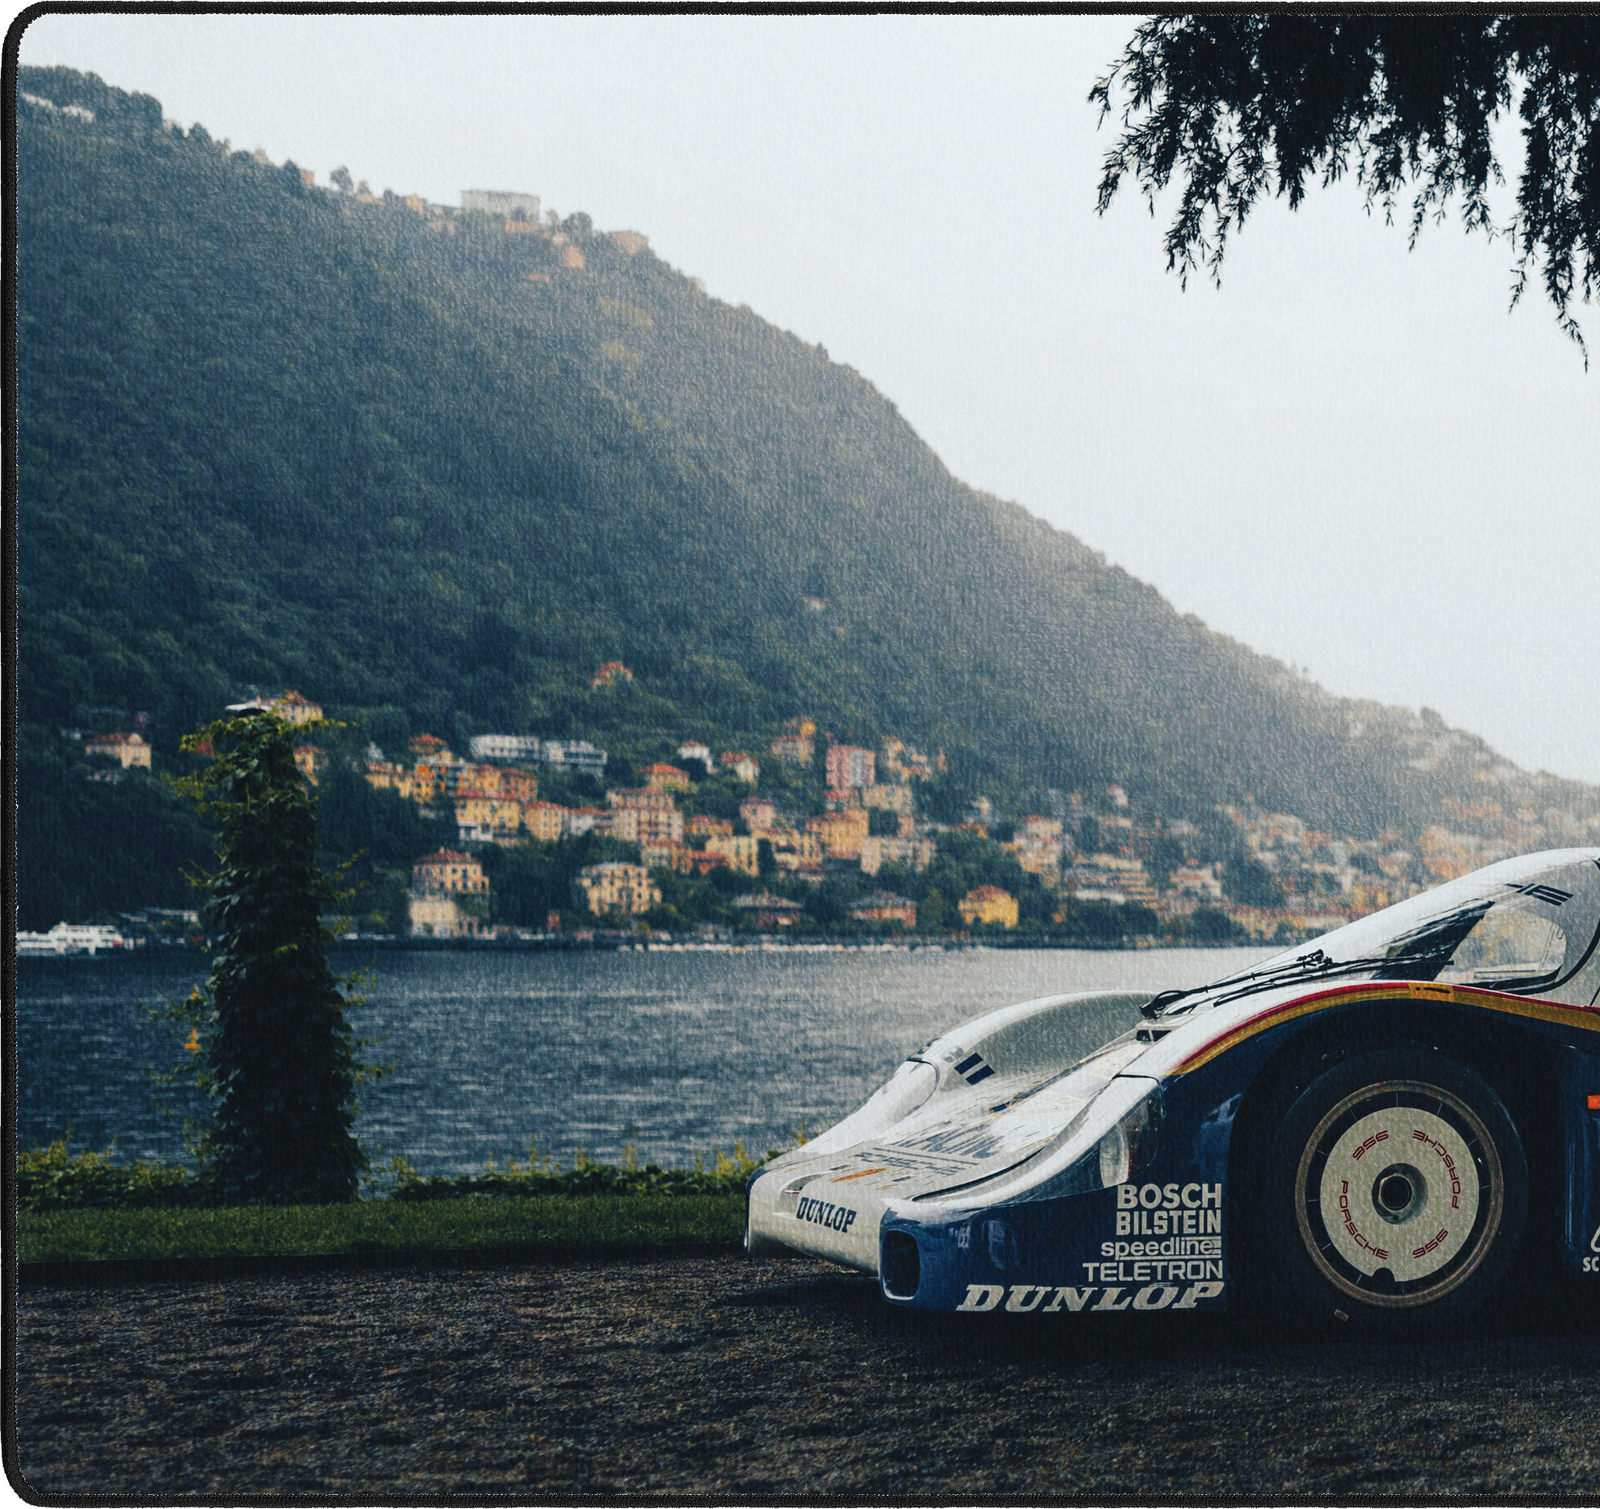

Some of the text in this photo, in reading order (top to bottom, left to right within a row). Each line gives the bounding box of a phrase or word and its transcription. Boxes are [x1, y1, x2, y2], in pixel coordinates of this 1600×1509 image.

[1412, 1129, 1461, 1209] PORSCHE
[1117, 1183, 1222, 1209] BOSCH
[796, 1197, 857, 1233] DUNLOP
[1116, 1210, 1222, 1235] BILSTEIN
[1339, 1180, 1389, 1260] PORSCHE
[1101, 1237, 1216, 1261] speedline
[1083, 1260, 1224, 1282] TELETRON
[956, 1281, 1225, 1312] DUNLOP
